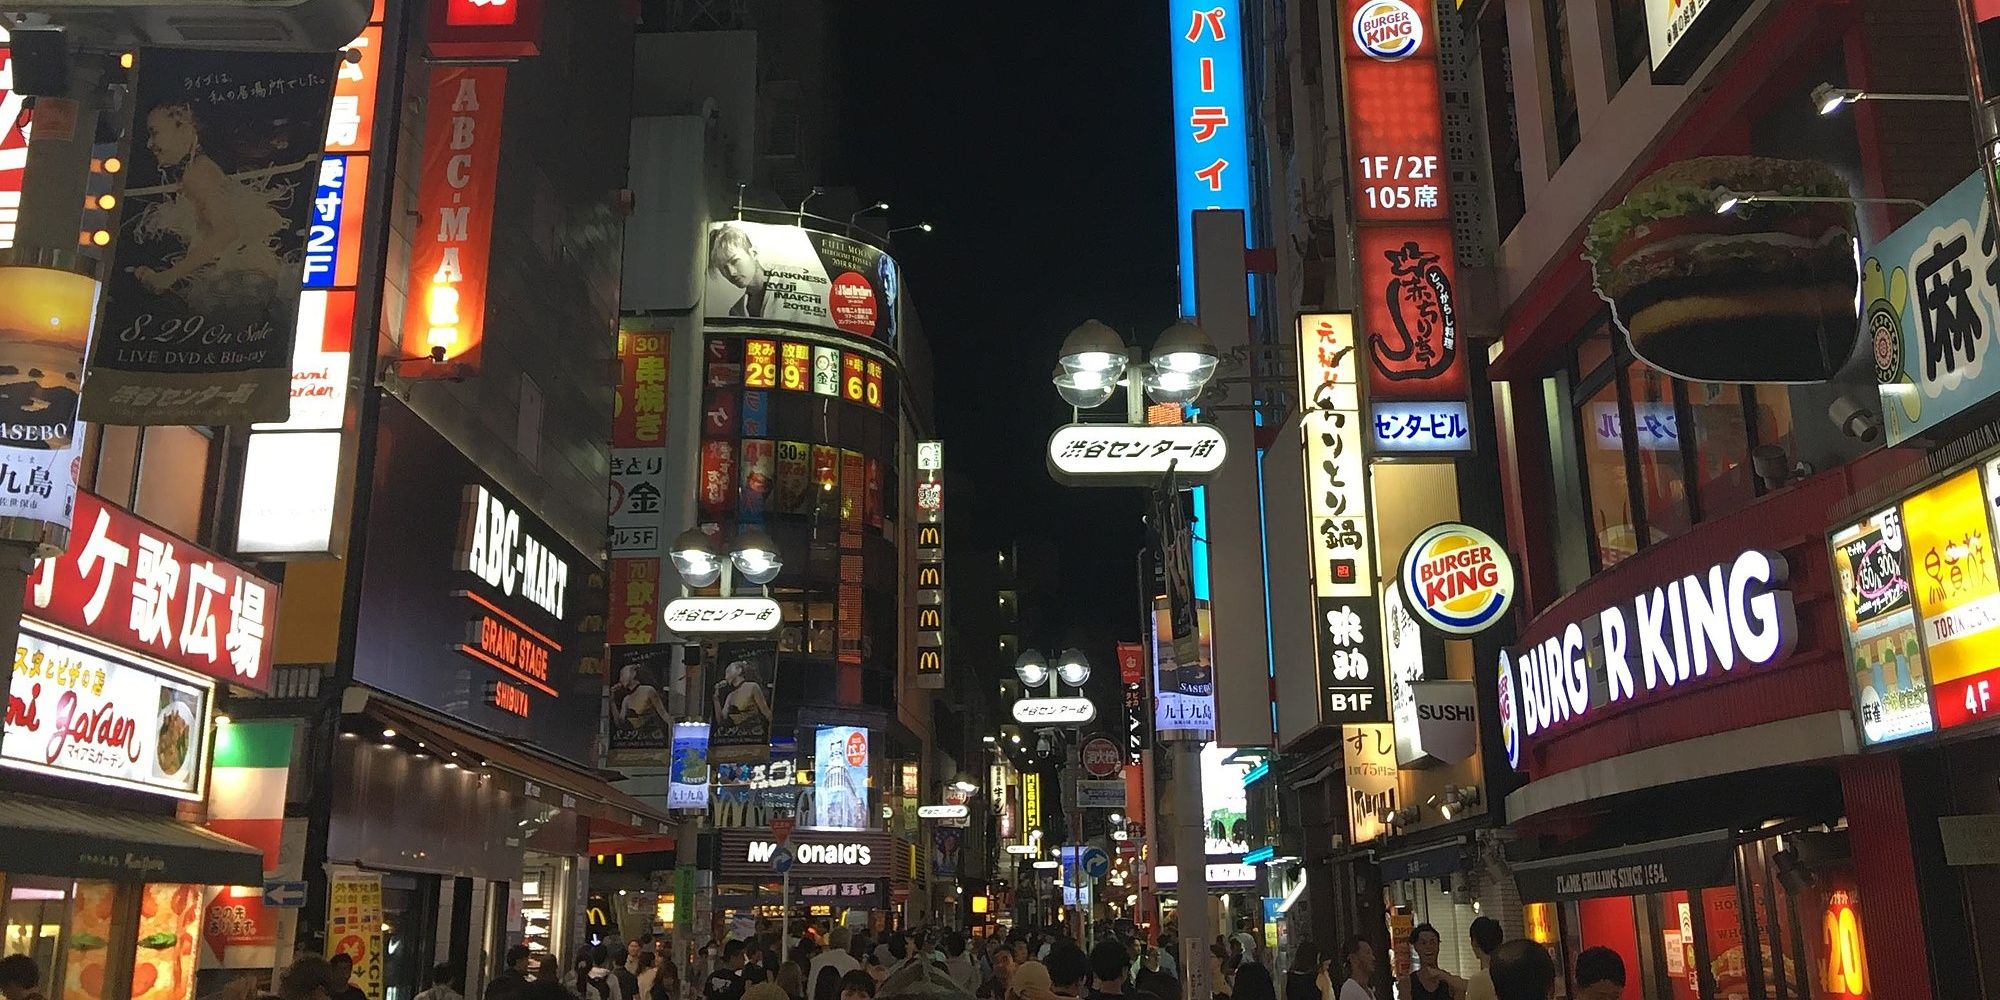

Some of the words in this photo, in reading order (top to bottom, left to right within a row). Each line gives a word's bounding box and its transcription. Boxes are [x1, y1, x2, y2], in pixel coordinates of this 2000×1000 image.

[1363, 11, 1410, 33] BURGER
[1366, 21, 1412, 48] KING
[1365, 184, 1438, 210] 105席
[302, 158, 345, 284] 受付2F
[763, 268, 828, 285] DARKNESS
[120, 313, 204, 344] 8.29
[118, 350, 157, 364] LIVE
[164, 351, 200, 365] DVD
[1375, 413, 1468, 440] センタービル
[1060, 439, 1219, 459] 渋谷センター街
[628, 481, 662, 514] 金
[470, 484, 568, 621] ABC-MART
[1421, 546, 1493, 582] BURGER
[1426, 563, 1499, 609] KING
[669, 607, 776, 622] 渋谷センター街
[481, 616, 517, 665] GRAND
[518, 637, 548, 681] STAGE
[1518, 606, 1635, 736] BURGER
[1634, 550, 1780, 690] KING
[495, 681, 529, 718] SHIBUYA
[1331, 693, 1373, 712] B1F
[1965, 680, 1991, 715] 4F
[1164, 703, 1212, 721] 九十九島
[1418, 703, 1475, 722] SUSHI
[1346, 728, 1393, 757] すし
[67, 744, 126, 769] マイアミガーデン
[1618, 865, 1644, 887] SINCE
